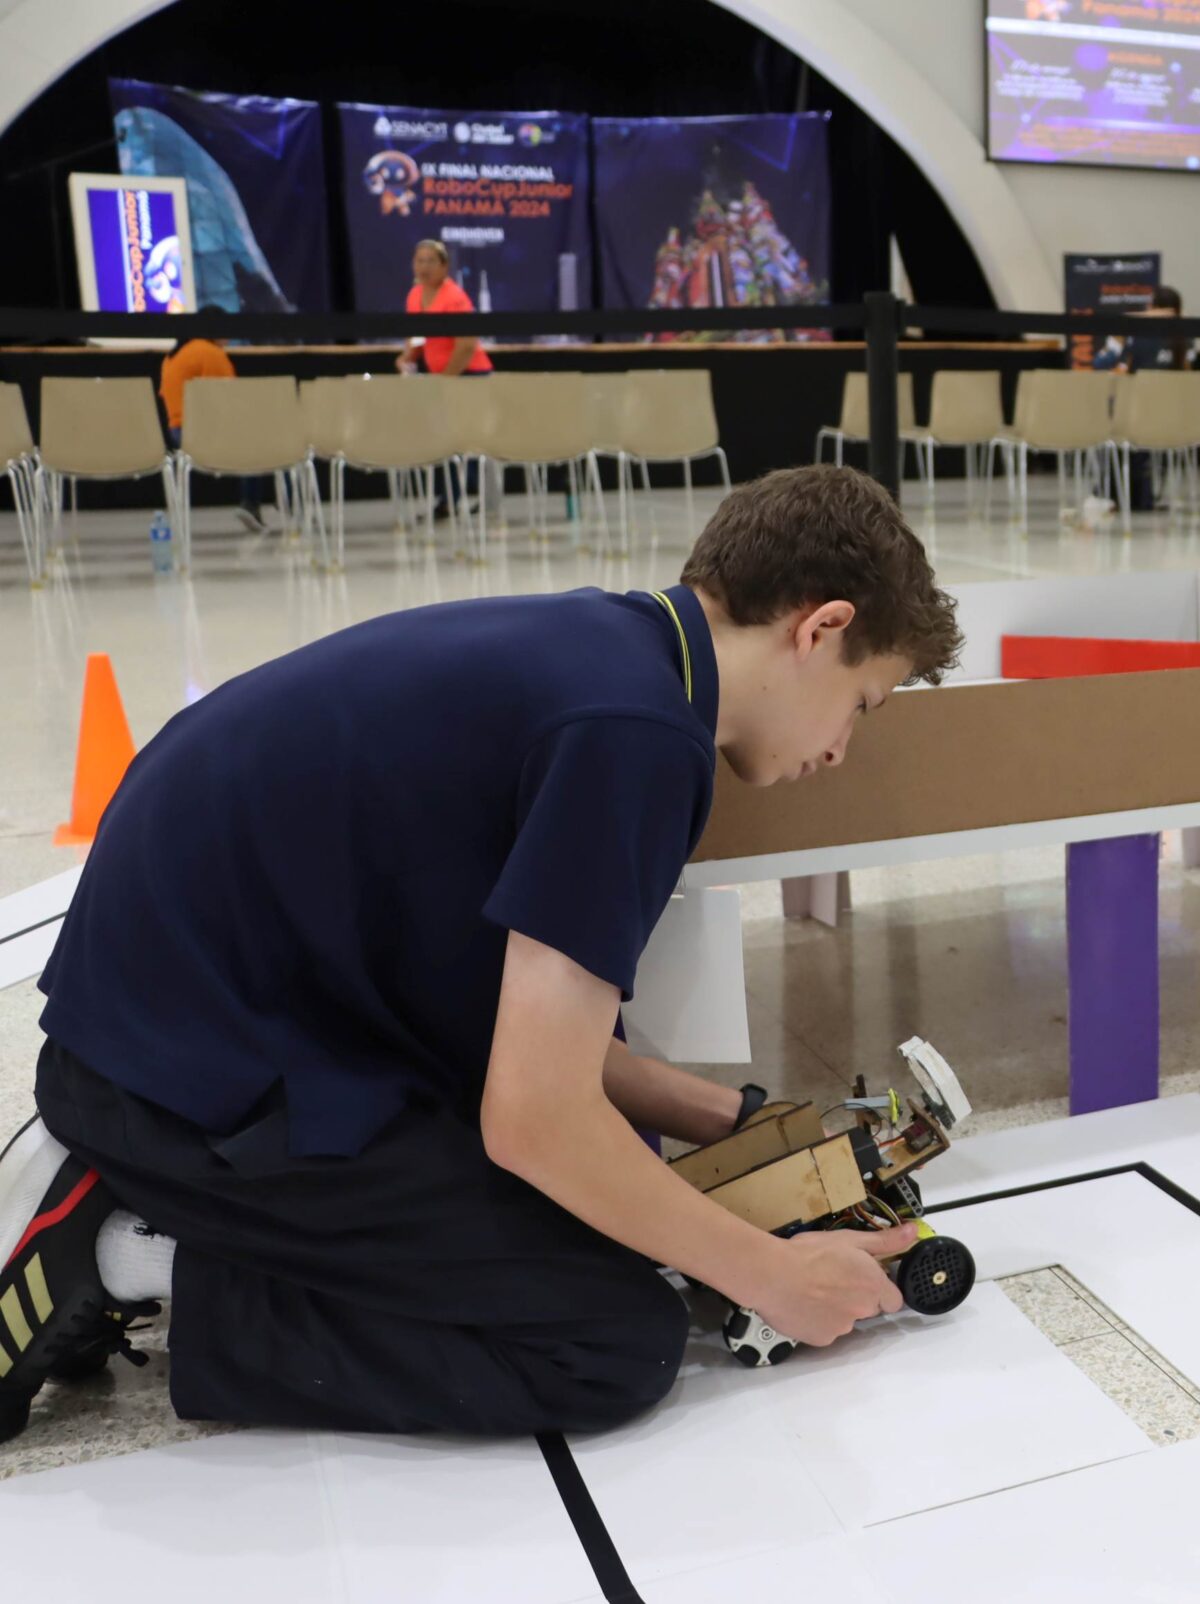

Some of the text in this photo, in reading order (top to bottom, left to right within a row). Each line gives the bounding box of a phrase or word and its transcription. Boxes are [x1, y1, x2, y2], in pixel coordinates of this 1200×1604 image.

[439, 164, 478, 178] FINAL
[480, 165, 554, 181] NACIONAL
[423, 177, 573, 199] RoboCupJunior
[510, 201, 550, 217] 2024
